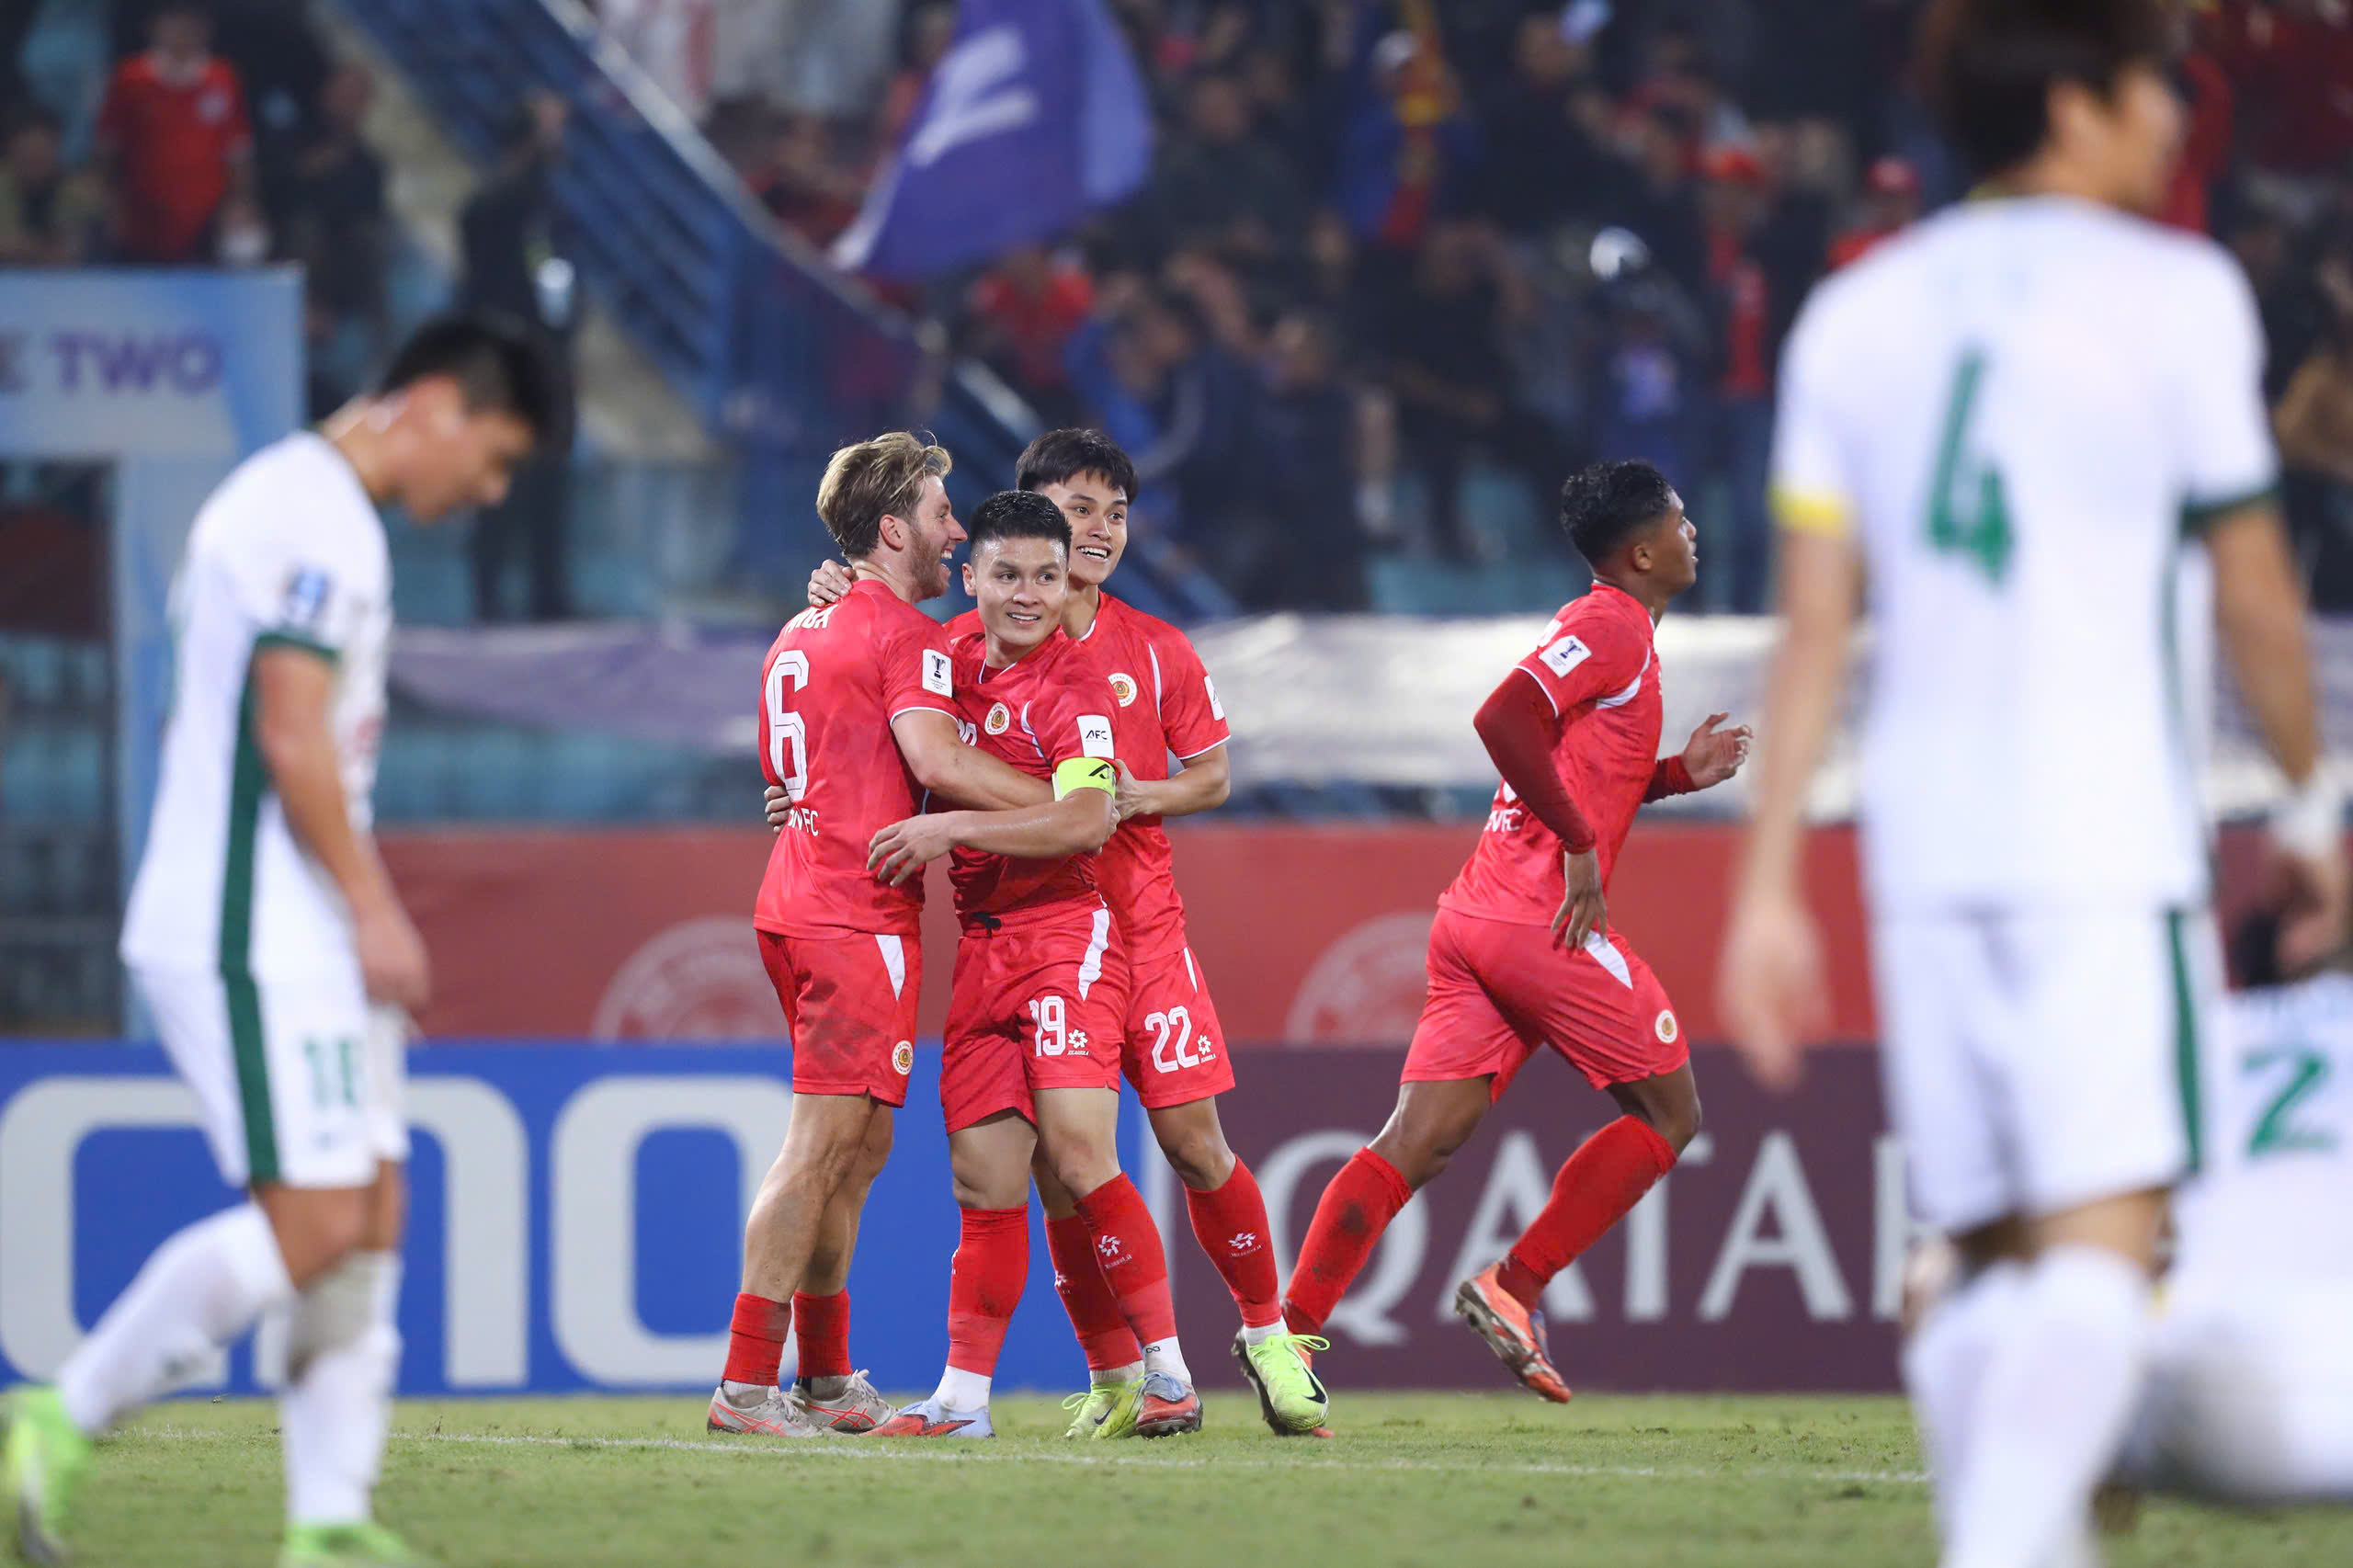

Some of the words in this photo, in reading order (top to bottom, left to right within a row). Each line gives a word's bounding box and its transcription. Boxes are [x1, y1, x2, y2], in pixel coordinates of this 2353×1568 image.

[52, 329, 223, 393] TWO
[1927, 345, 2015, 588] 4
[766, 649, 810, 801] 6
[1086, 729, 1108, 741] AFC
[1028, 995, 1066, 1057] 19
[1144, 1005, 1199, 1074] 22
[2241, 1046, 2342, 1162] 2
